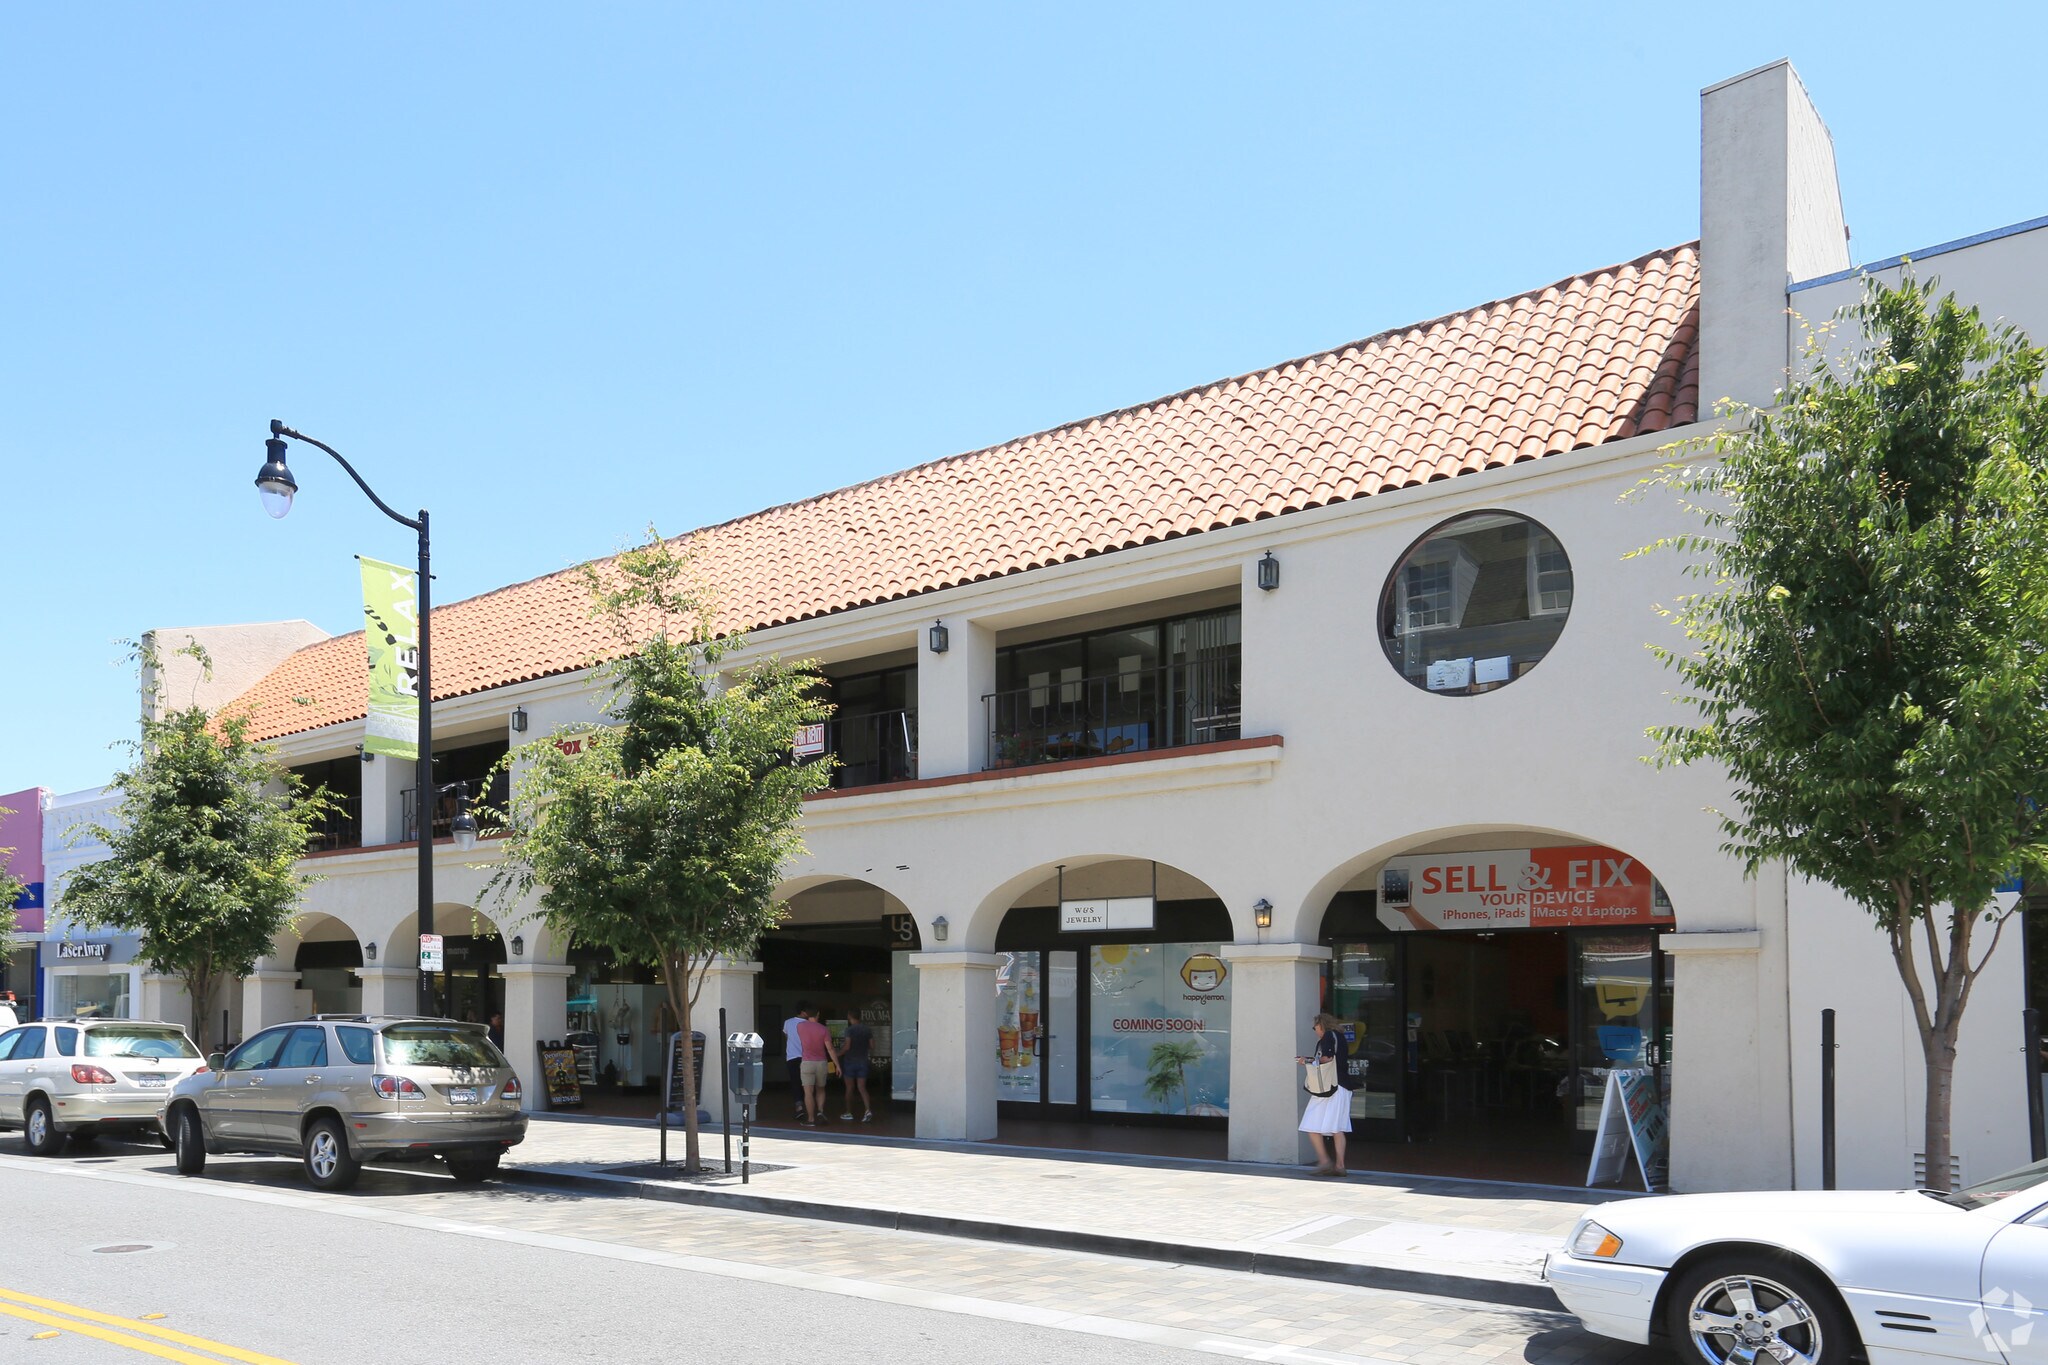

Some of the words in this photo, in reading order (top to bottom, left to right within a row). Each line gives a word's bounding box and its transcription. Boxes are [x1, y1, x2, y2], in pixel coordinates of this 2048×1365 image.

[390, 569, 419, 698] RELAX
[1422, 865, 1507, 894] SELL
[1518, 862, 1553, 891] &
[1568, 858, 1633, 888] FIX
[1480, 893, 1527, 906] YOUR
[1533, 890, 1595, 905] DEVICE
[1066, 916, 1102, 924] JEWELRY
[1443, 909, 1491, 920] iPhones,
[1495, 908, 1526, 919] iPads
[1533, 906, 1568, 917] iMacs
[1571, 906, 1583, 917] &
[1587, 905, 1638, 918] Laptops
[57, 942, 107, 961] LaserAway
[1113, 1019, 1163, 1032] COMING
[1166, 1018, 1204, 1032] SOON
